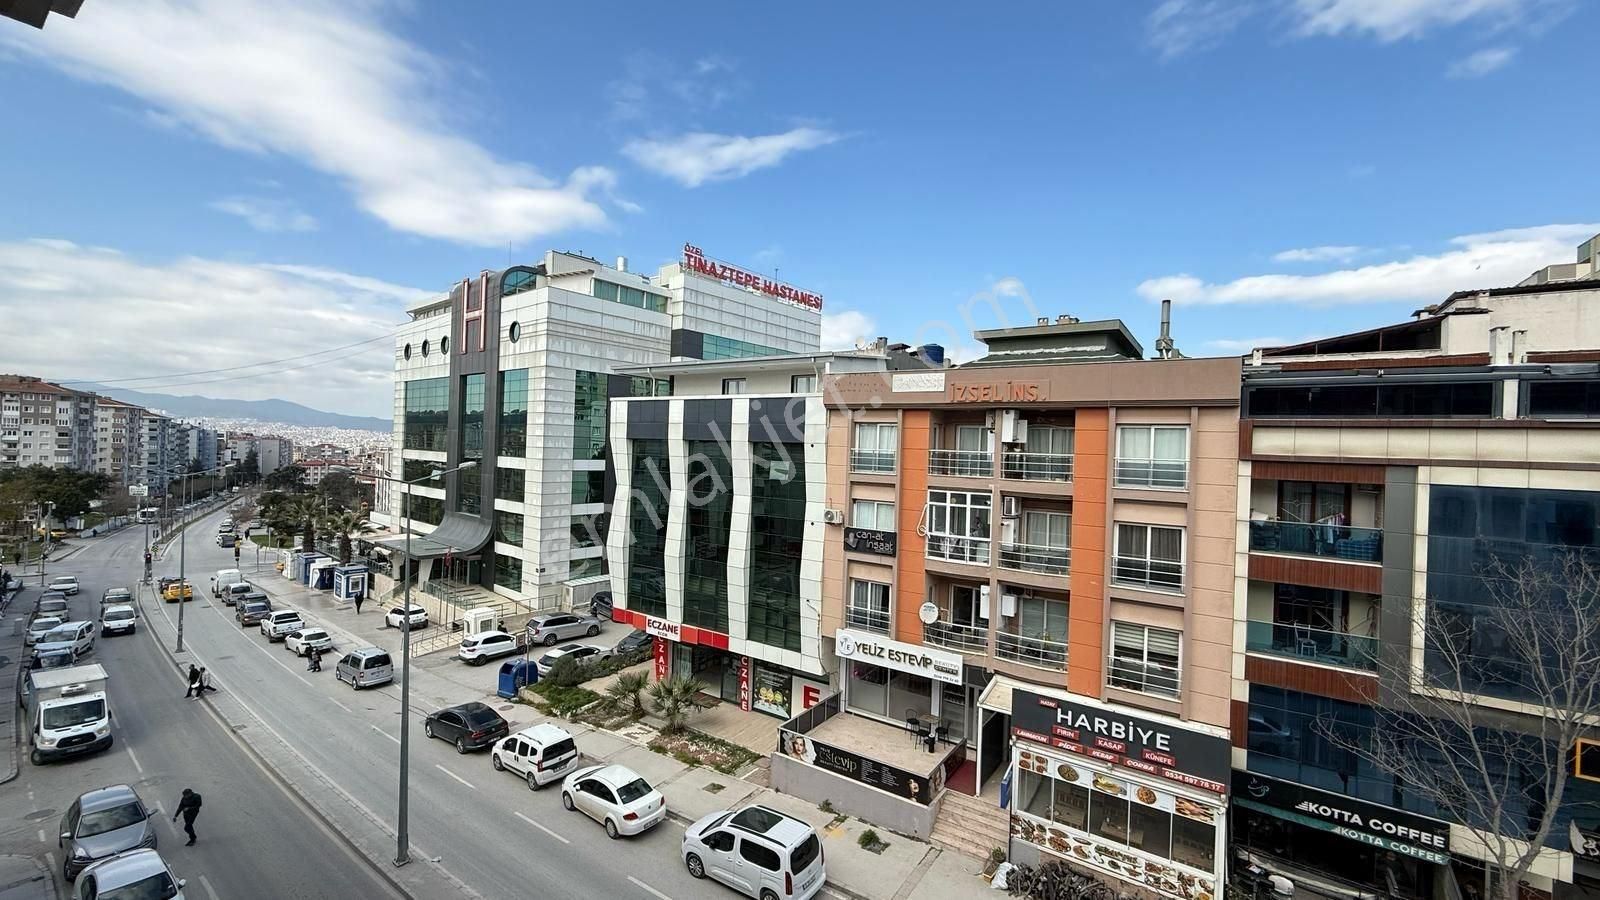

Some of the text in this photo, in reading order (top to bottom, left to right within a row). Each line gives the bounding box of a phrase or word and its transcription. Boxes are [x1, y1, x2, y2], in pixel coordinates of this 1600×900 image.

[684, 242, 704, 257] ÖZEL
[684, 252, 823, 311] TINAZTEPE HASTANESİ
[461, 272, 488, 355] H
[647, 619, 679, 635] ECZANE
[855, 641, 933, 668] YELİZ ESTEVİP
[1056, 707, 1170, 752] HARBİYE
[1057, 728, 1075, 738] FIRIN
[1098, 739, 1122, 751] KASAP
[1092, 750, 1114, 760] KEBAP
[1145, 752, 1172, 765] KÜNEFE
[1165, 771, 1183, 781] 0534
[1307, 802, 1445, 848] KOTTA COFFEE
[1340, 828, 1443, 863] KOTTA COFFEE
